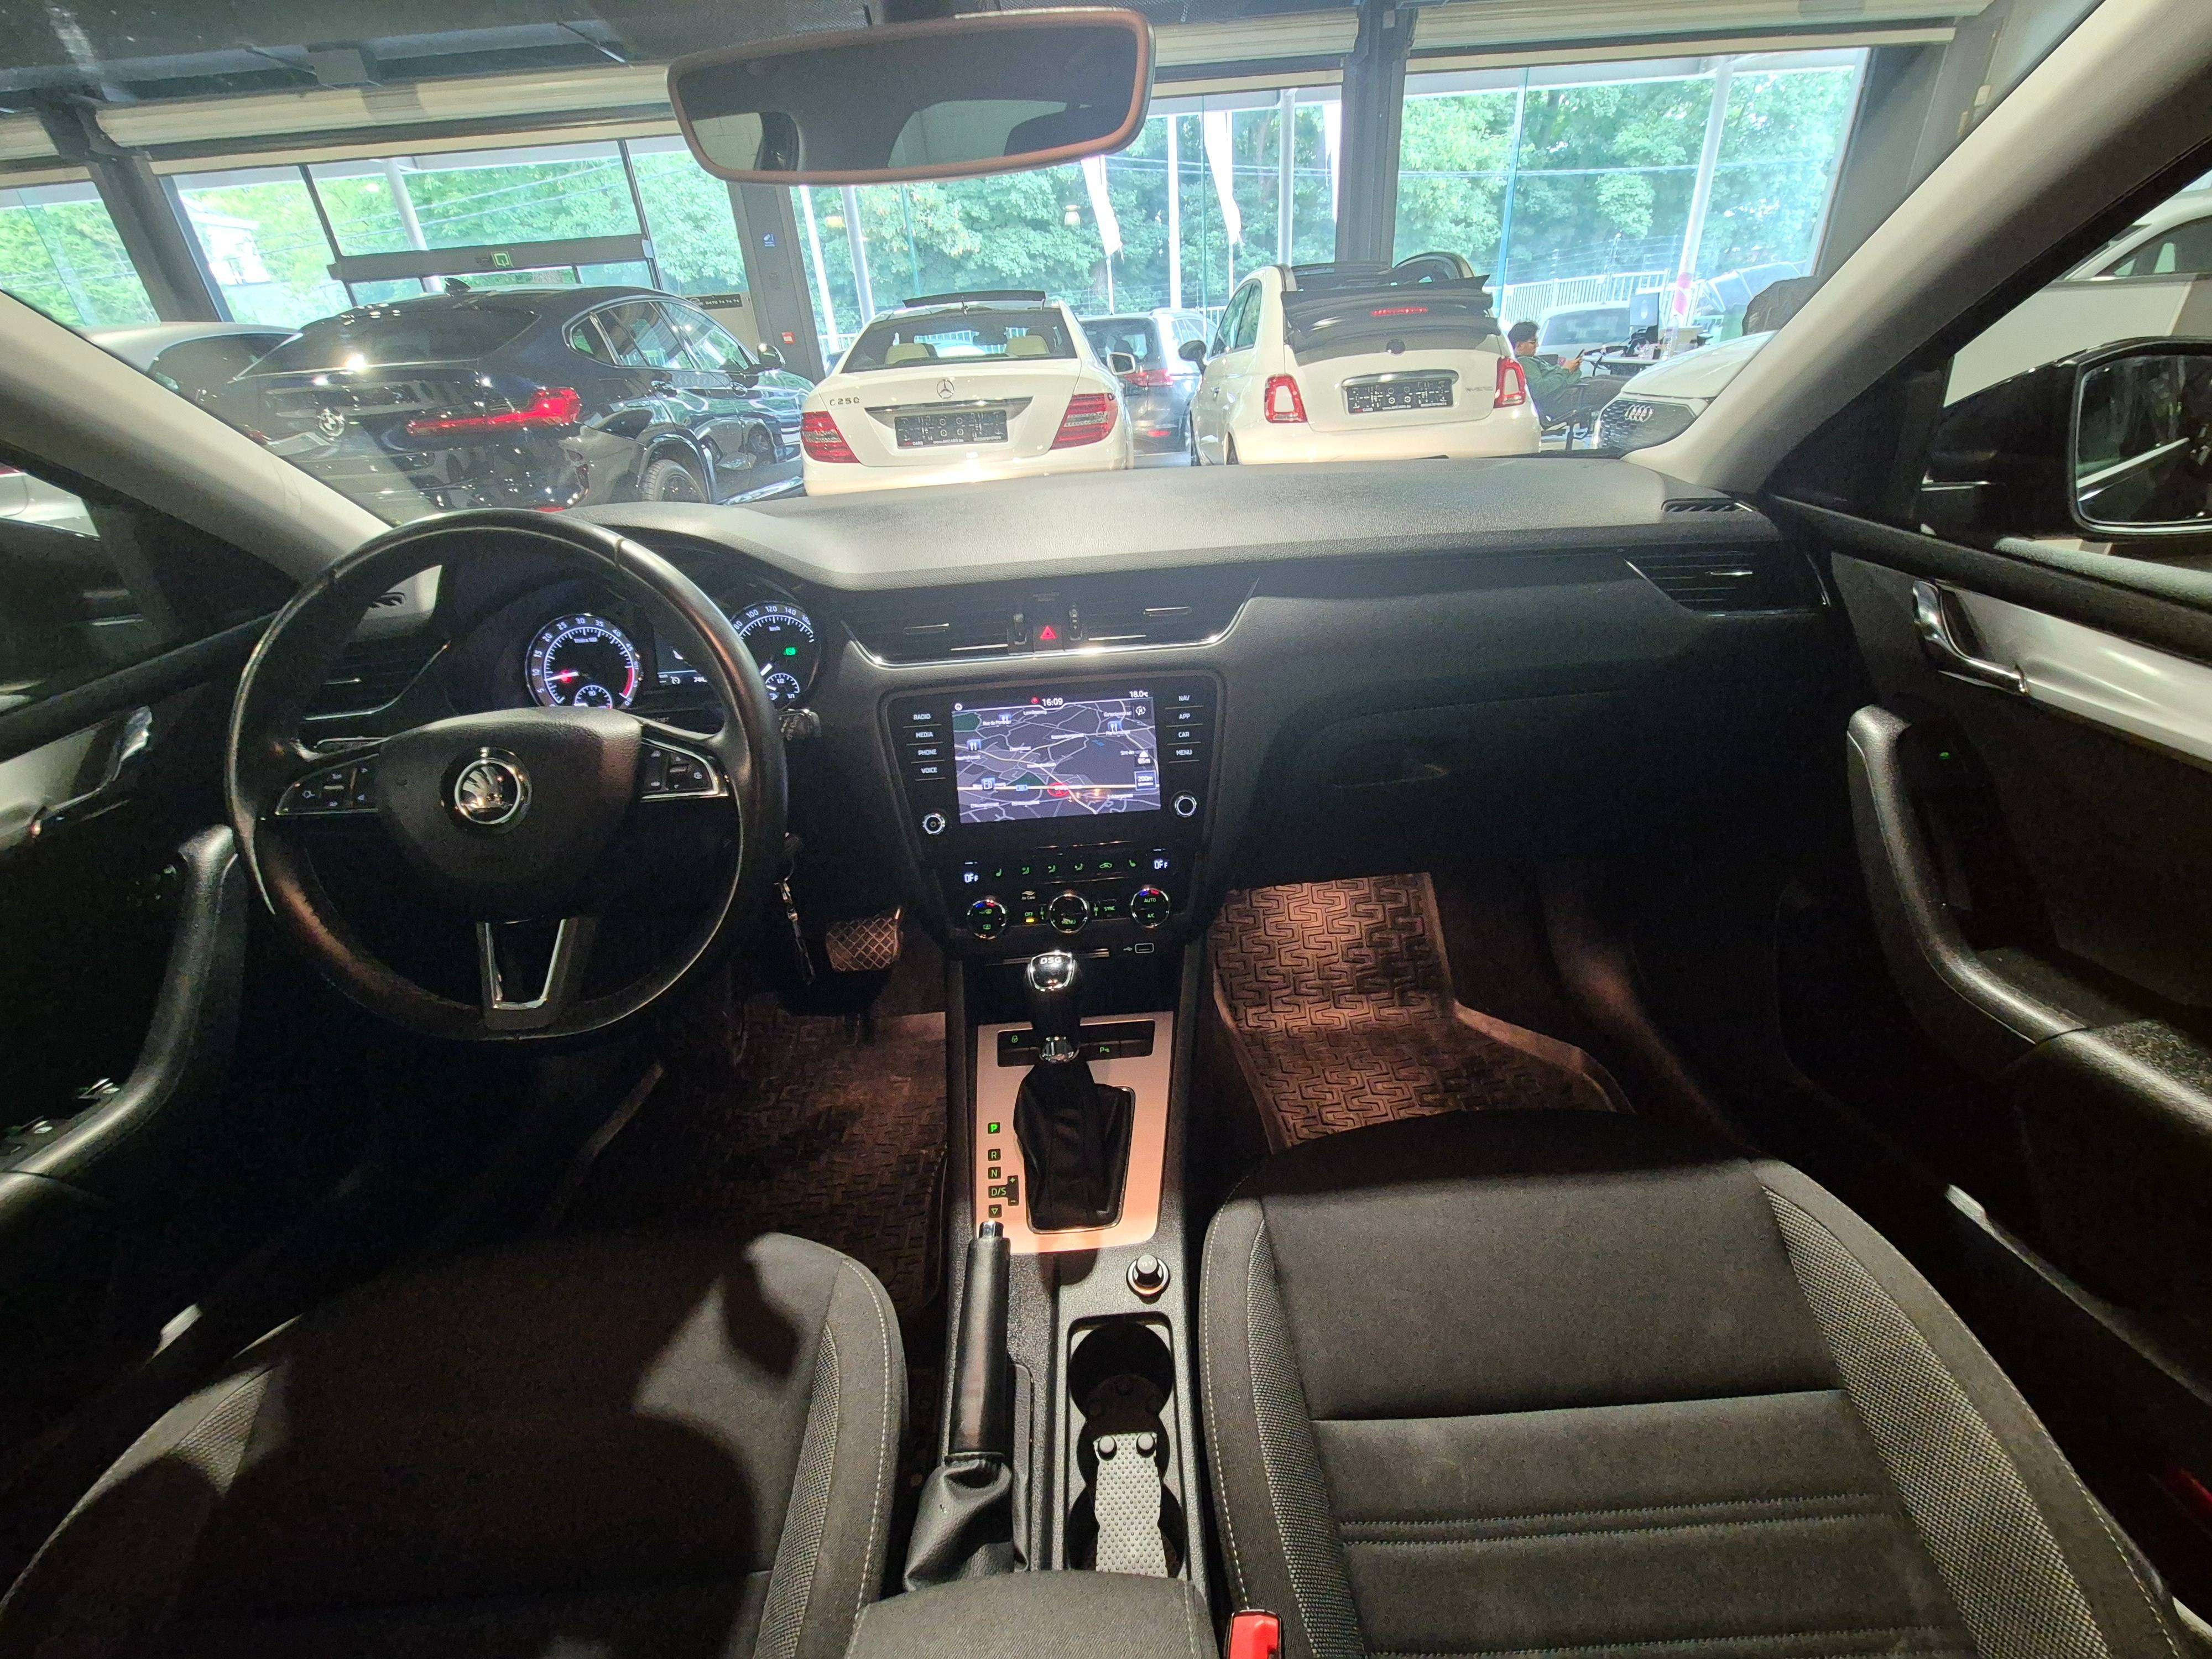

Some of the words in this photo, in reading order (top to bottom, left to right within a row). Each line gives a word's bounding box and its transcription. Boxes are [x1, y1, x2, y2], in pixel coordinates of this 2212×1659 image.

[838, 397, 860, 405] 250
[746, 609, 759, 618] 100
[784, 607, 796, 615] 140
[556, 622, 567, 630] 25
[595, 619, 604, 628] 35
[542, 633, 553, 643] 20
[625, 643, 633, 651] 45
[533, 650, 542, 658] 15
[531, 668, 540, 676] 10
[1041, 697, 1063, 707] 16:09
[1154, 859, 1168, 870] OFF
[964, 872, 979, 883] OFF
[1040, 957, 1062, 965] DSG
[990, 1124, 998, 1133] P
[991, 1151, 997, 1159] R
[991, 1169, 998, 1177] N
[991, 1187, 1006, 1196] D/S
